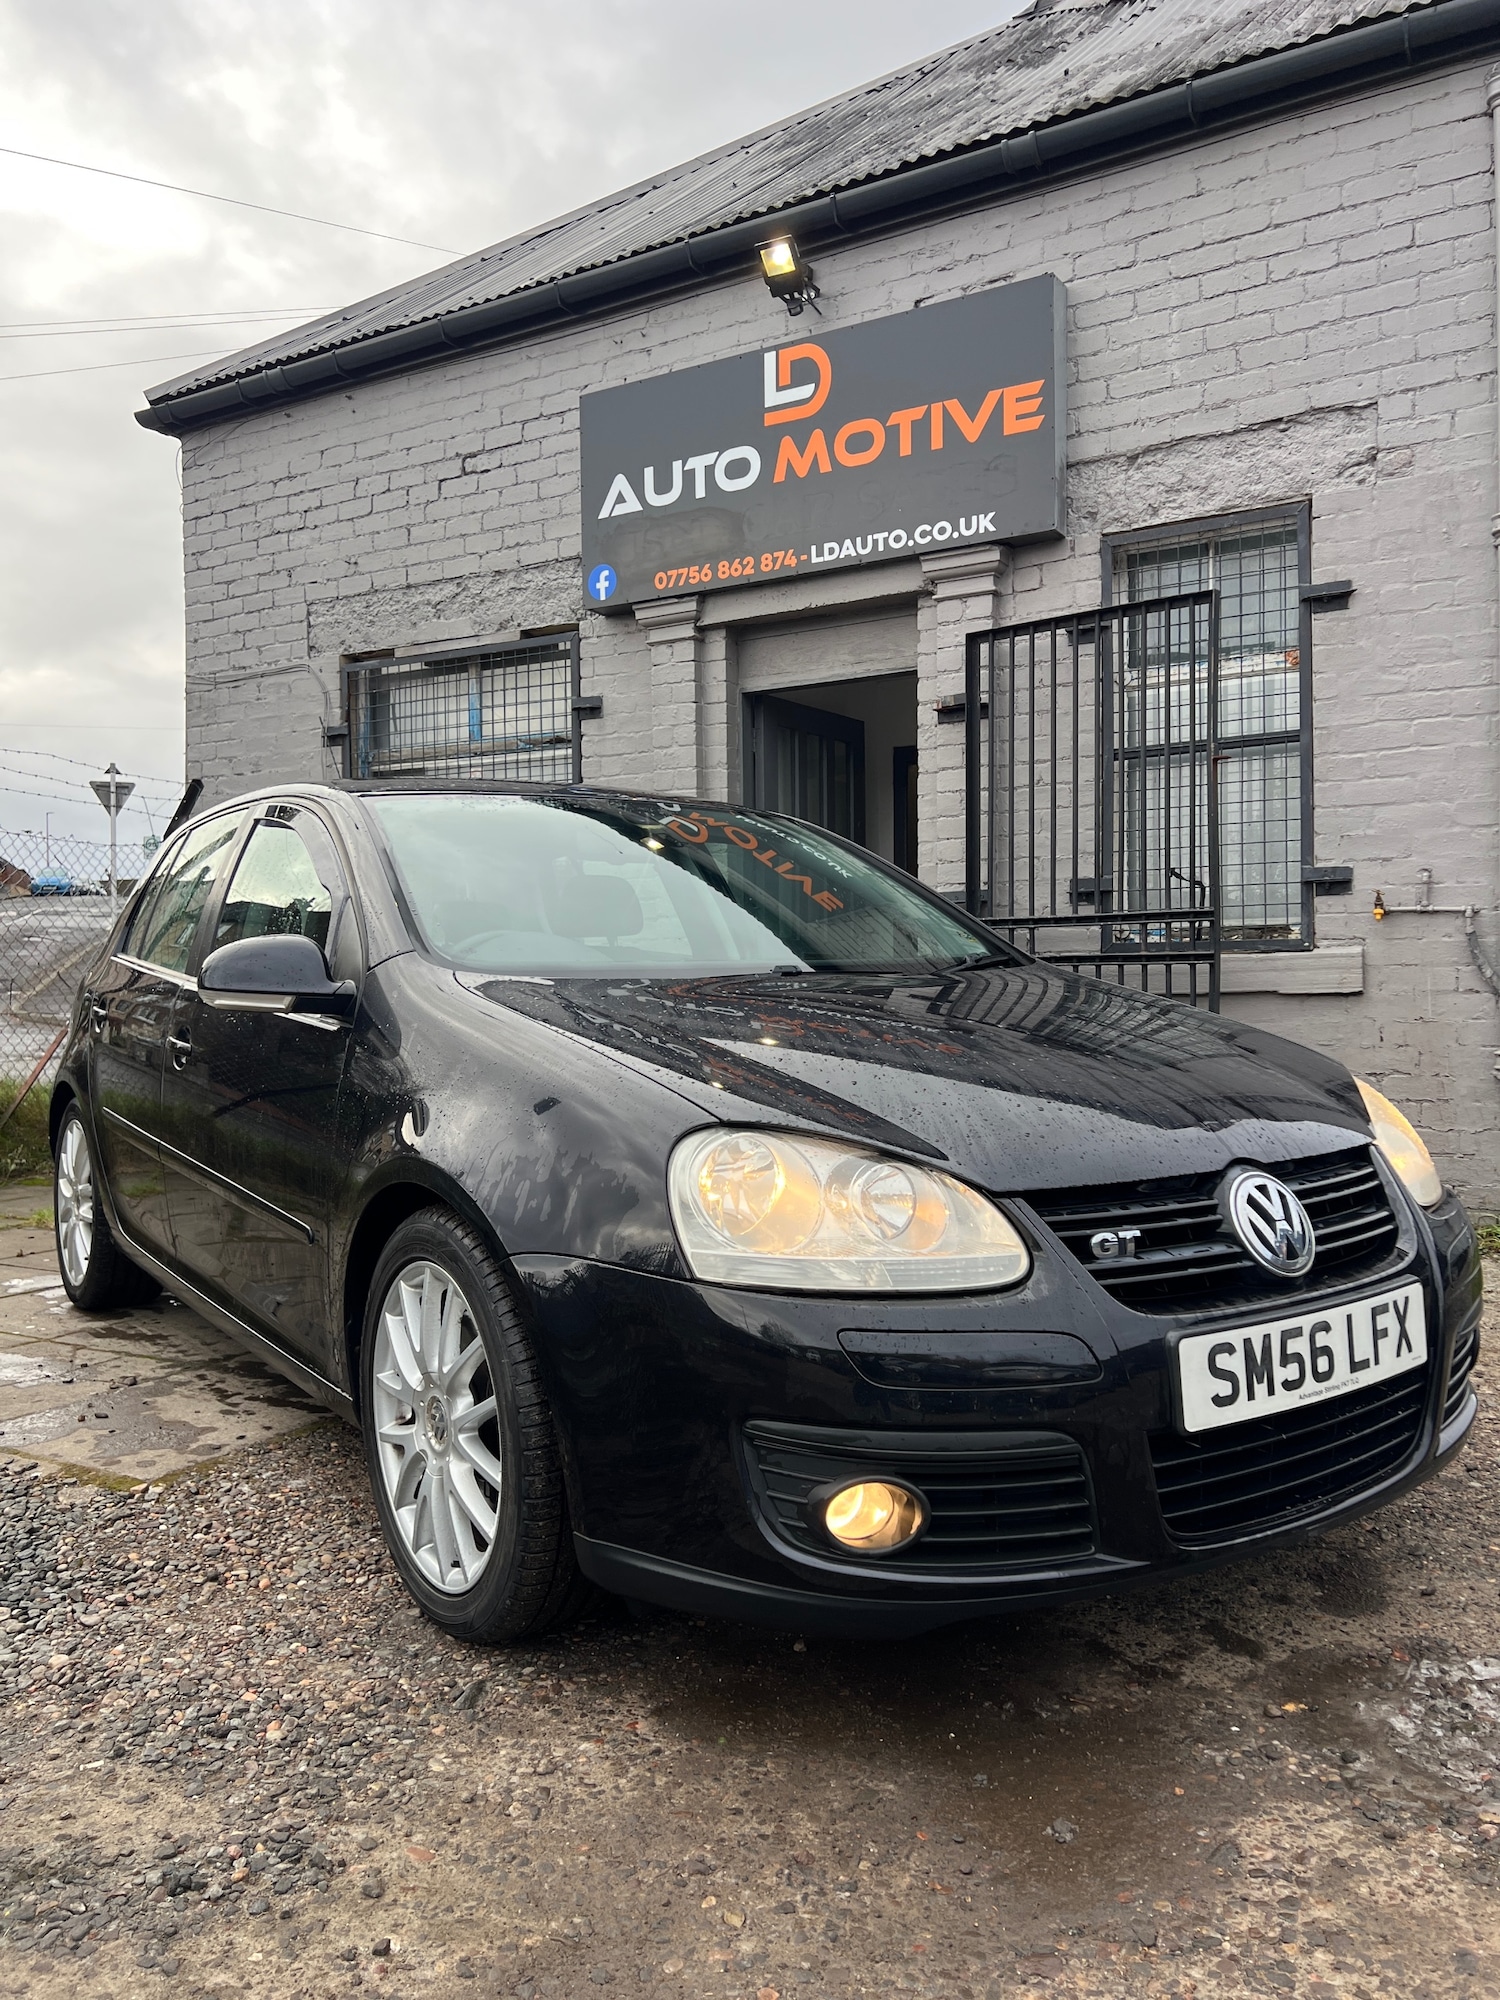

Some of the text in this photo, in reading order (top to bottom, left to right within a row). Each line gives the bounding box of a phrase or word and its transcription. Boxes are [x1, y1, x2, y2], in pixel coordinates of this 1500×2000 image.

[598, 445, 761, 519] AUTO
[773, 379, 1045, 483] MOTIVE
[654, 563, 712, 590] 07756
[717, 556, 755, 580] 862
[811, 512, 996, 563] LDAUTO.CO.UK
[1091, 1230, 1141, 1258] GT
[1208, 1296, 1413, 1408] SM56 LFX
